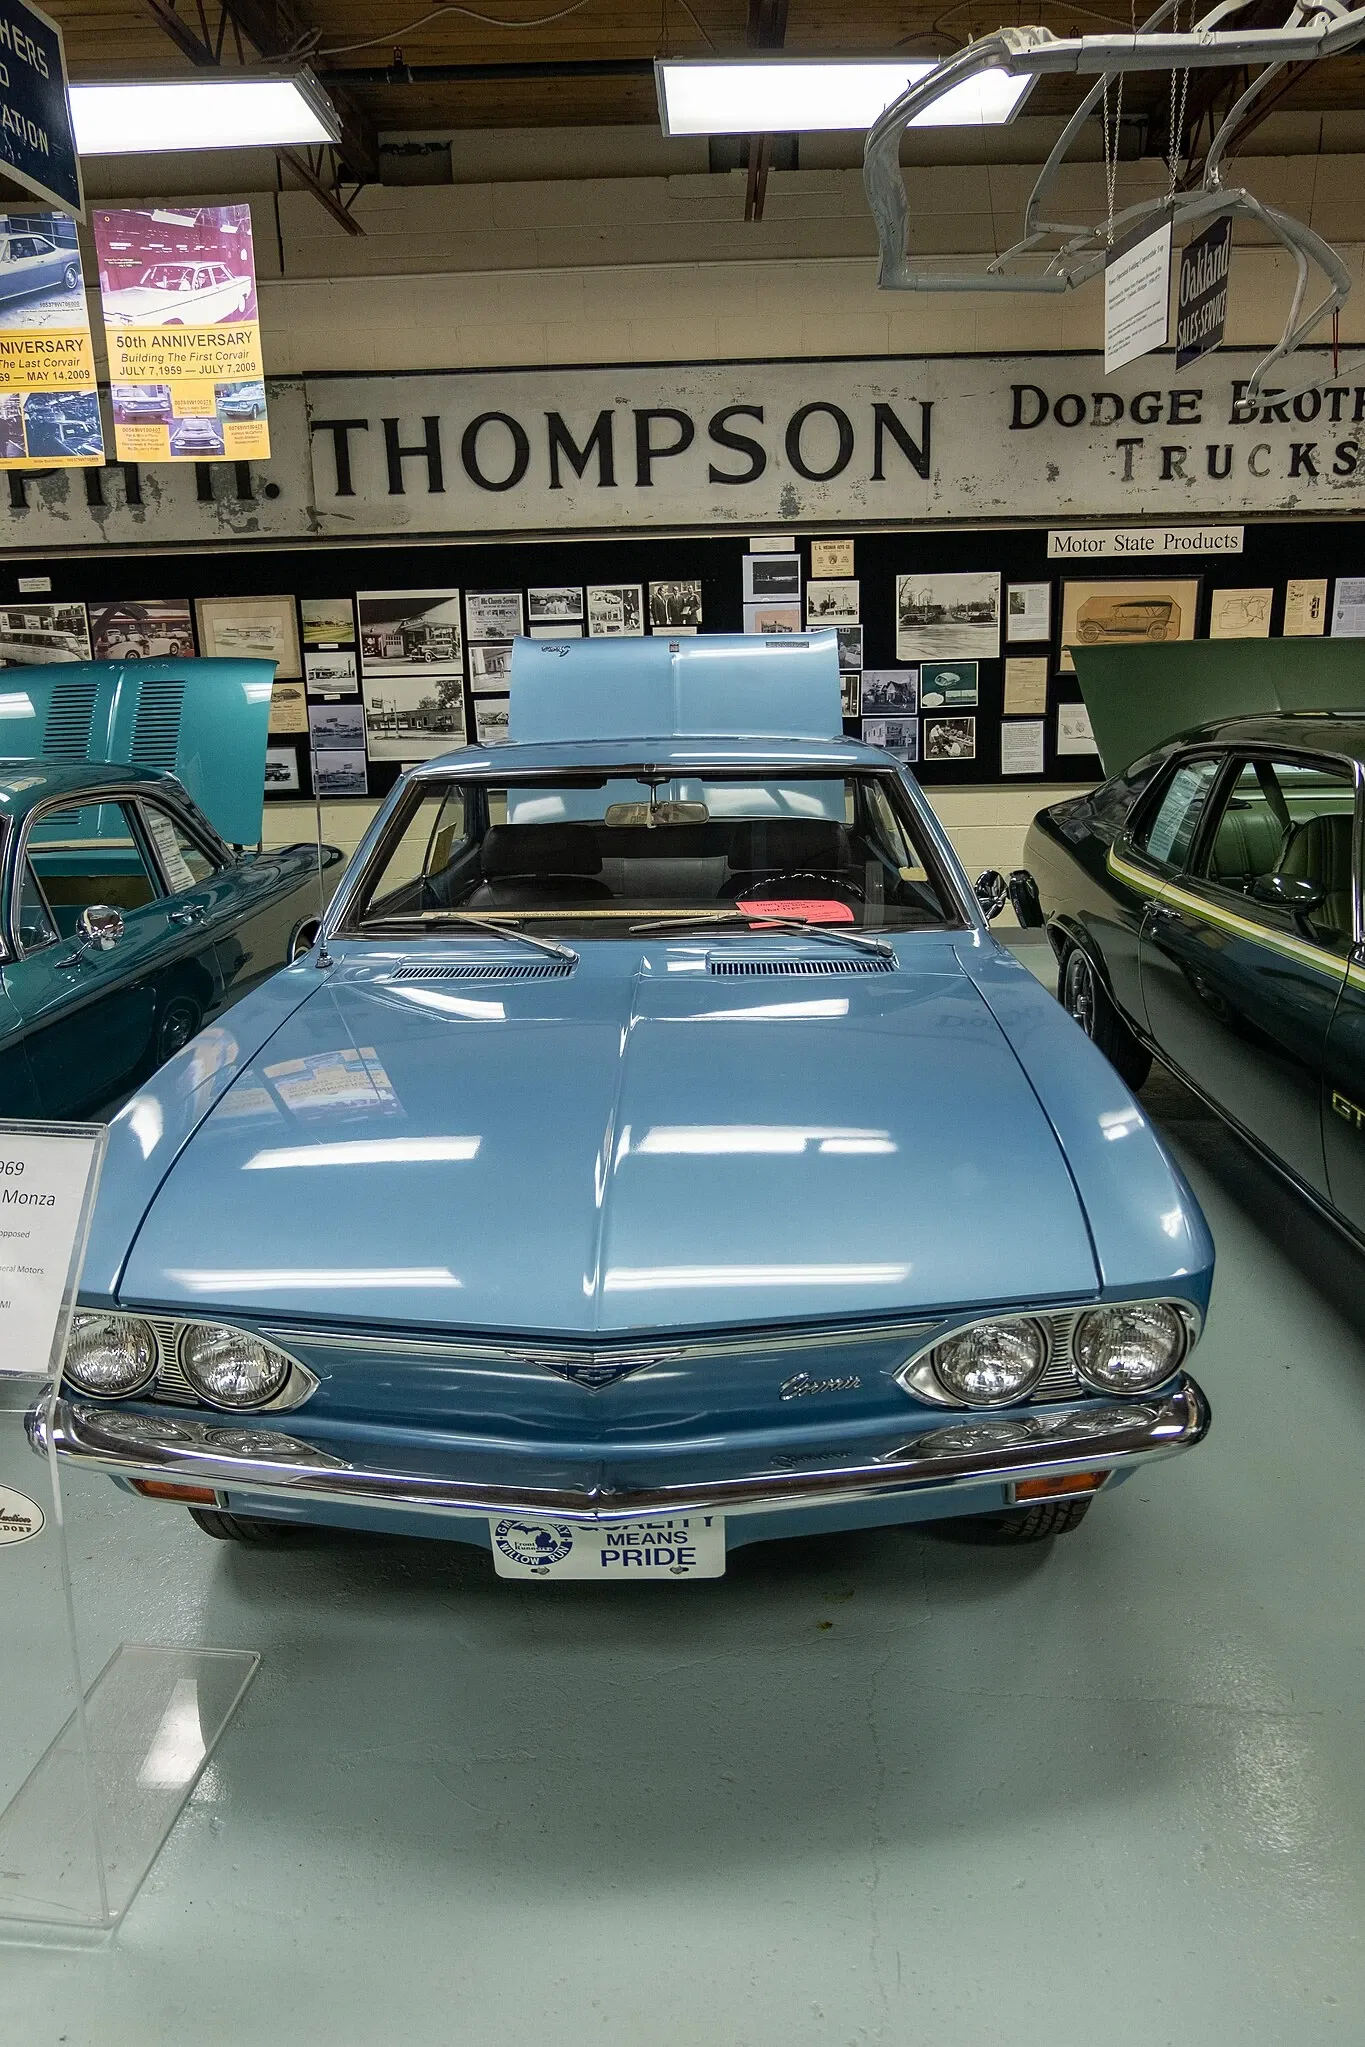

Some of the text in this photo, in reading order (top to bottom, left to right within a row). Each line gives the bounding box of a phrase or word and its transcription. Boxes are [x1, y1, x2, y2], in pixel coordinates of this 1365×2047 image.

[1180, 221, 1230, 308] Oakland
[116, 332, 252, 348] 50th ANNIVERSARY
[19, 359, 40, 368] Last
[44, 357, 80, 368] Corvair
[122, 350, 249, 364] Building The First Corvair
[27, 372, 49, 380] MAY
[120, 367, 146, 376] JULY
[149, 366, 182, 376] 7,1959
[199, 365, 224, 374] JULY
[227, 362, 256, 374] 7,2009
[1009, 384, 1202, 430] DODGE
[311, 402, 934, 496] THOMPSON
[1116, 438, 1359, 482] TRUCKS
[1054, 532, 1238, 554] Motor State Products
[2, 1190, 56, 1206] Monza
[17, 1266, 44, 1274] Motors
[606, 1531, 688, 1546] MEANS
[500, 1542, 570, 1564] WILLOW RUN
[600, 1547, 696, 1567] PRIDE
